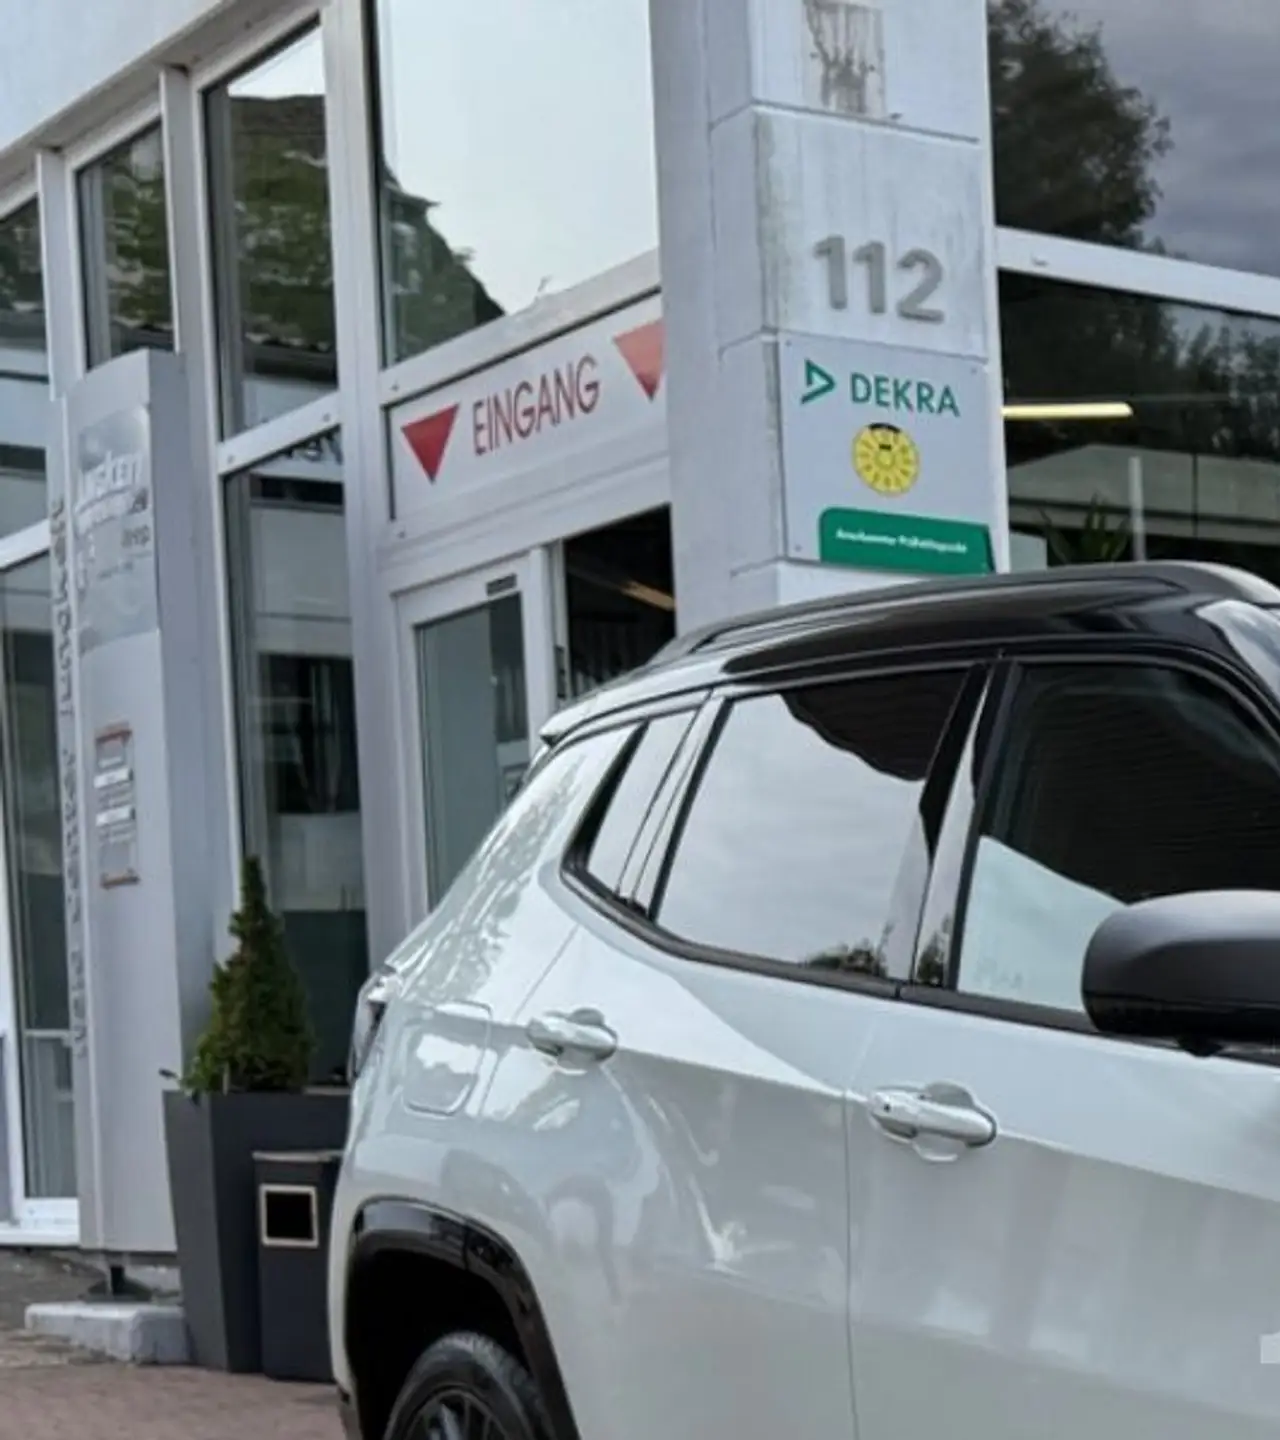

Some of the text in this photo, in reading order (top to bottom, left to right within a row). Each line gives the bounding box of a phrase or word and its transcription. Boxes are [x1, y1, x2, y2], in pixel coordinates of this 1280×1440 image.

[813, 235, 945, 325] 112
[472, 353, 600, 456] EINGANG
[851, 372, 961, 418] DEKRA
